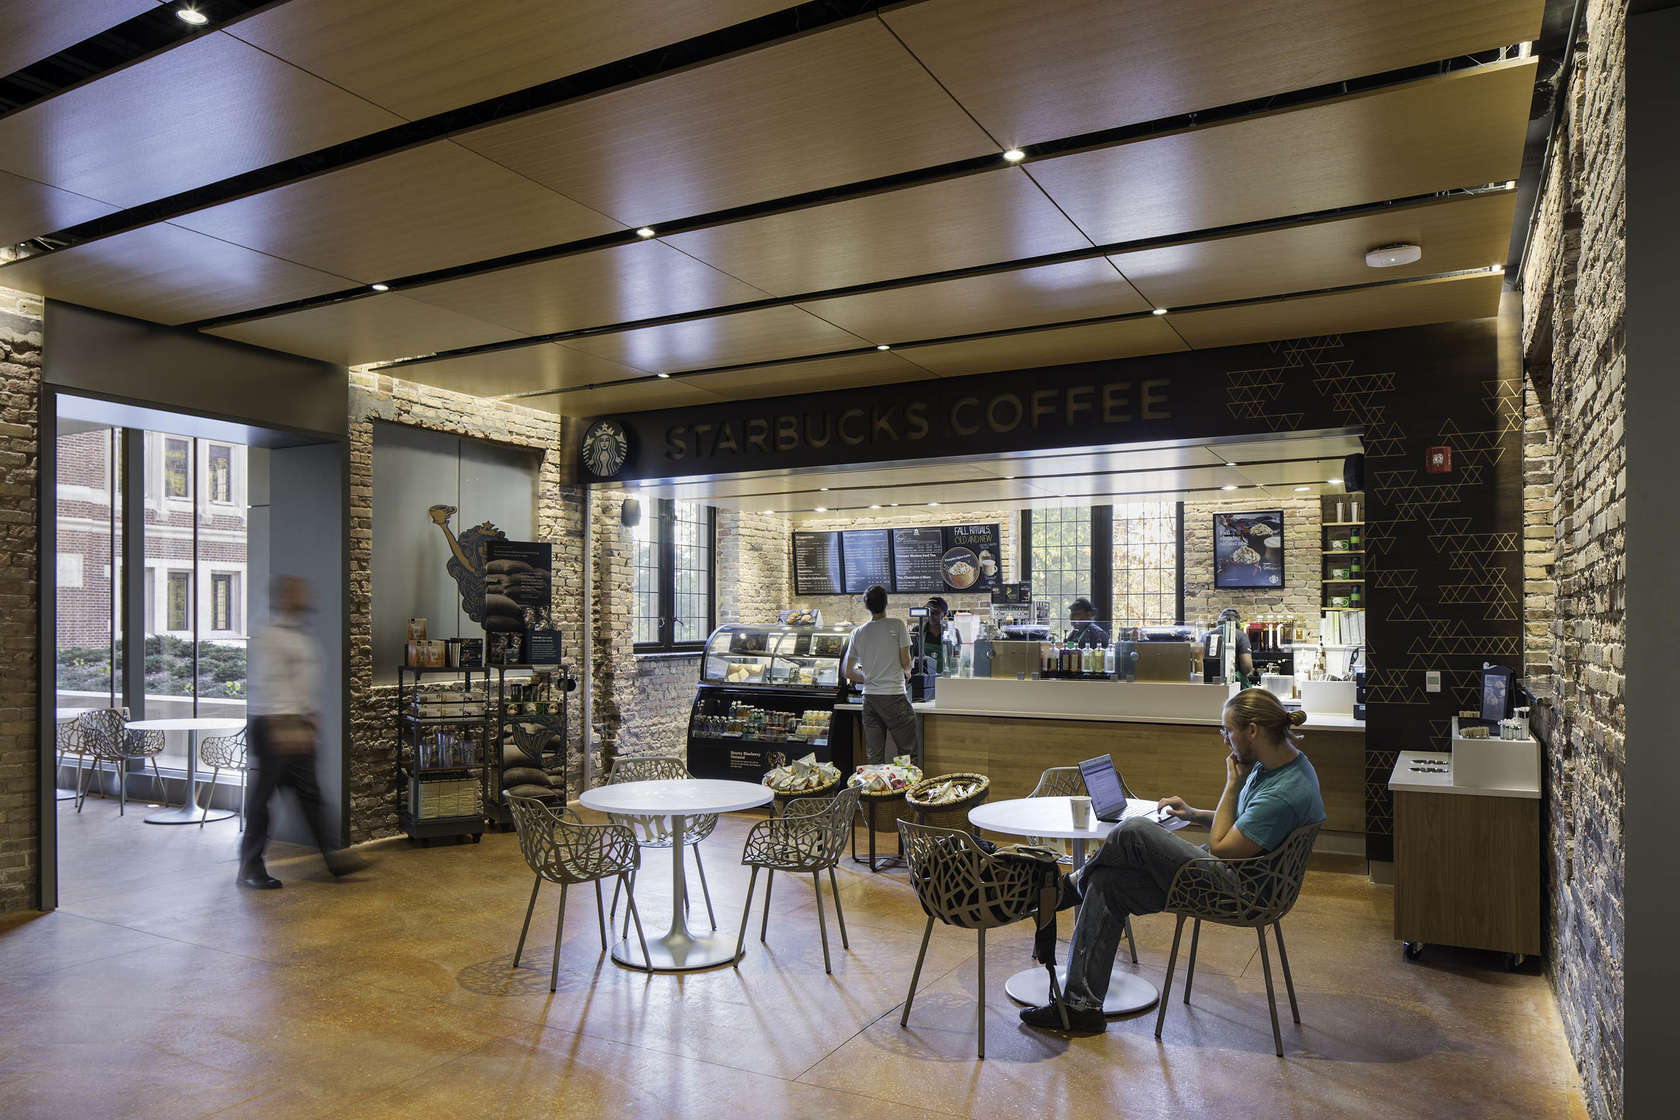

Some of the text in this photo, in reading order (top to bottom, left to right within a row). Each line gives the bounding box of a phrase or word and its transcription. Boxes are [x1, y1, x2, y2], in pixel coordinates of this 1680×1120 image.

[663, 378, 1172, 461] STARBUCKS COFFEE
[954, 526, 969, 536] FALL
